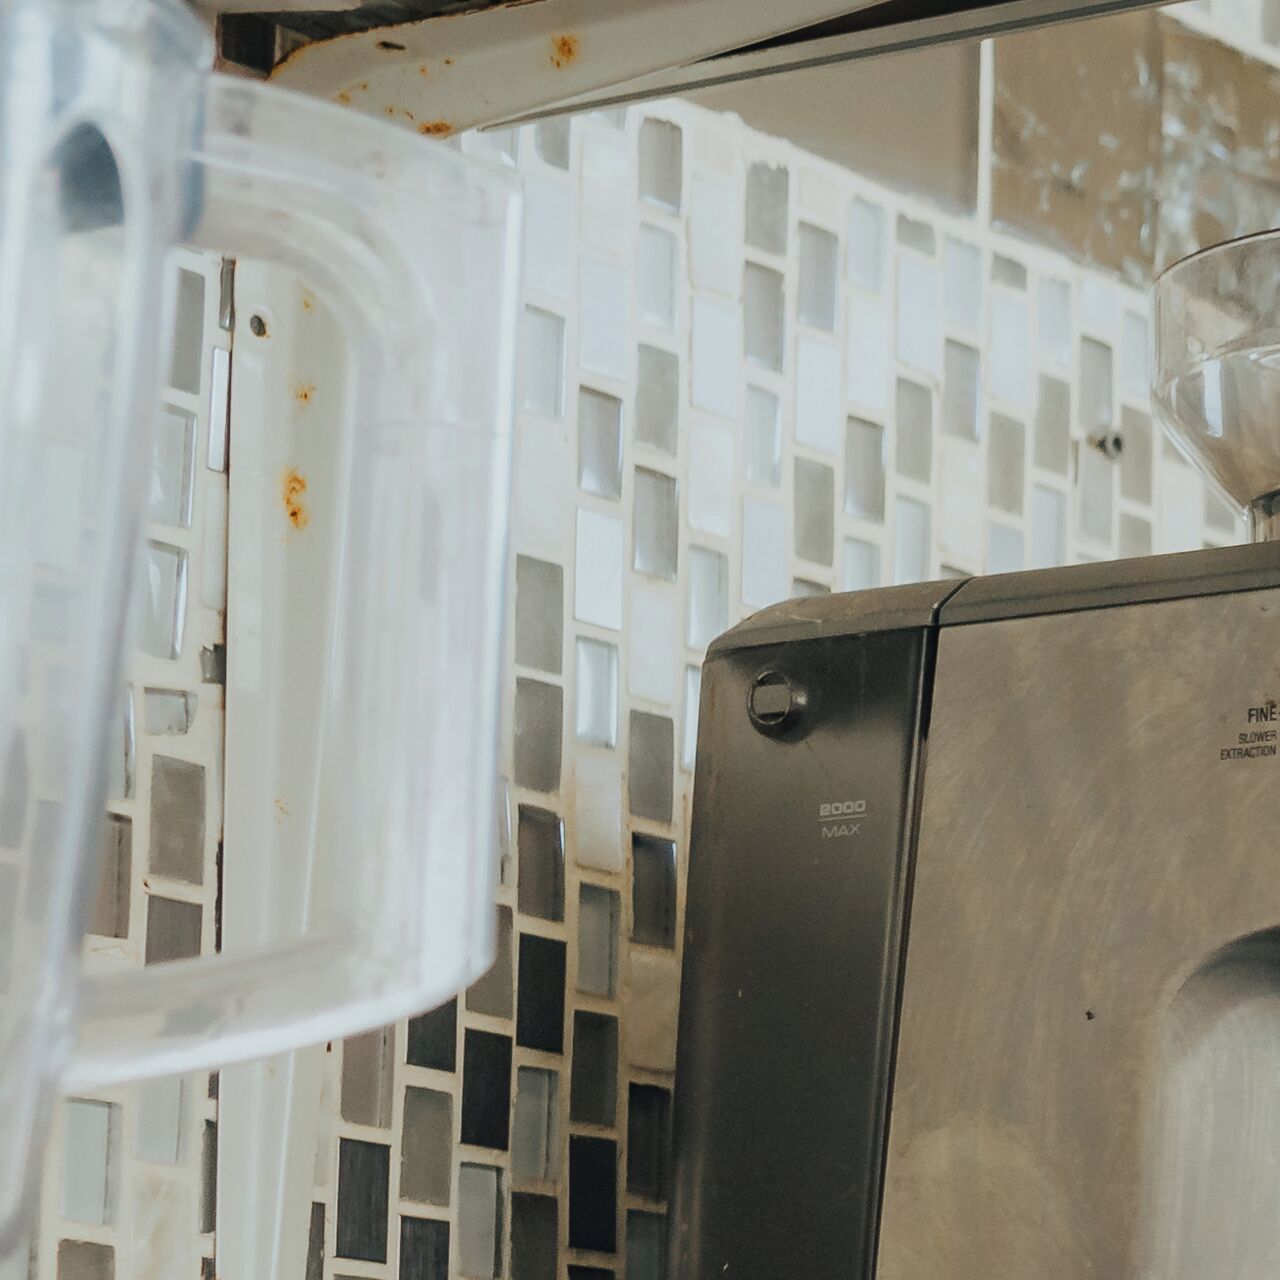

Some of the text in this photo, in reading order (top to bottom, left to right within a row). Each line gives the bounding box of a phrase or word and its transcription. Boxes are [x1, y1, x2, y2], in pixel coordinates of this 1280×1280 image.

[1247, 704, 1278, 723] FINE
[1238, 730, 1277, 745] SLOWER
[1220, 745, 1277, 760] EXTRACTION
[820, 799, 867, 817] 2000
[822, 824, 861, 838] MAX
